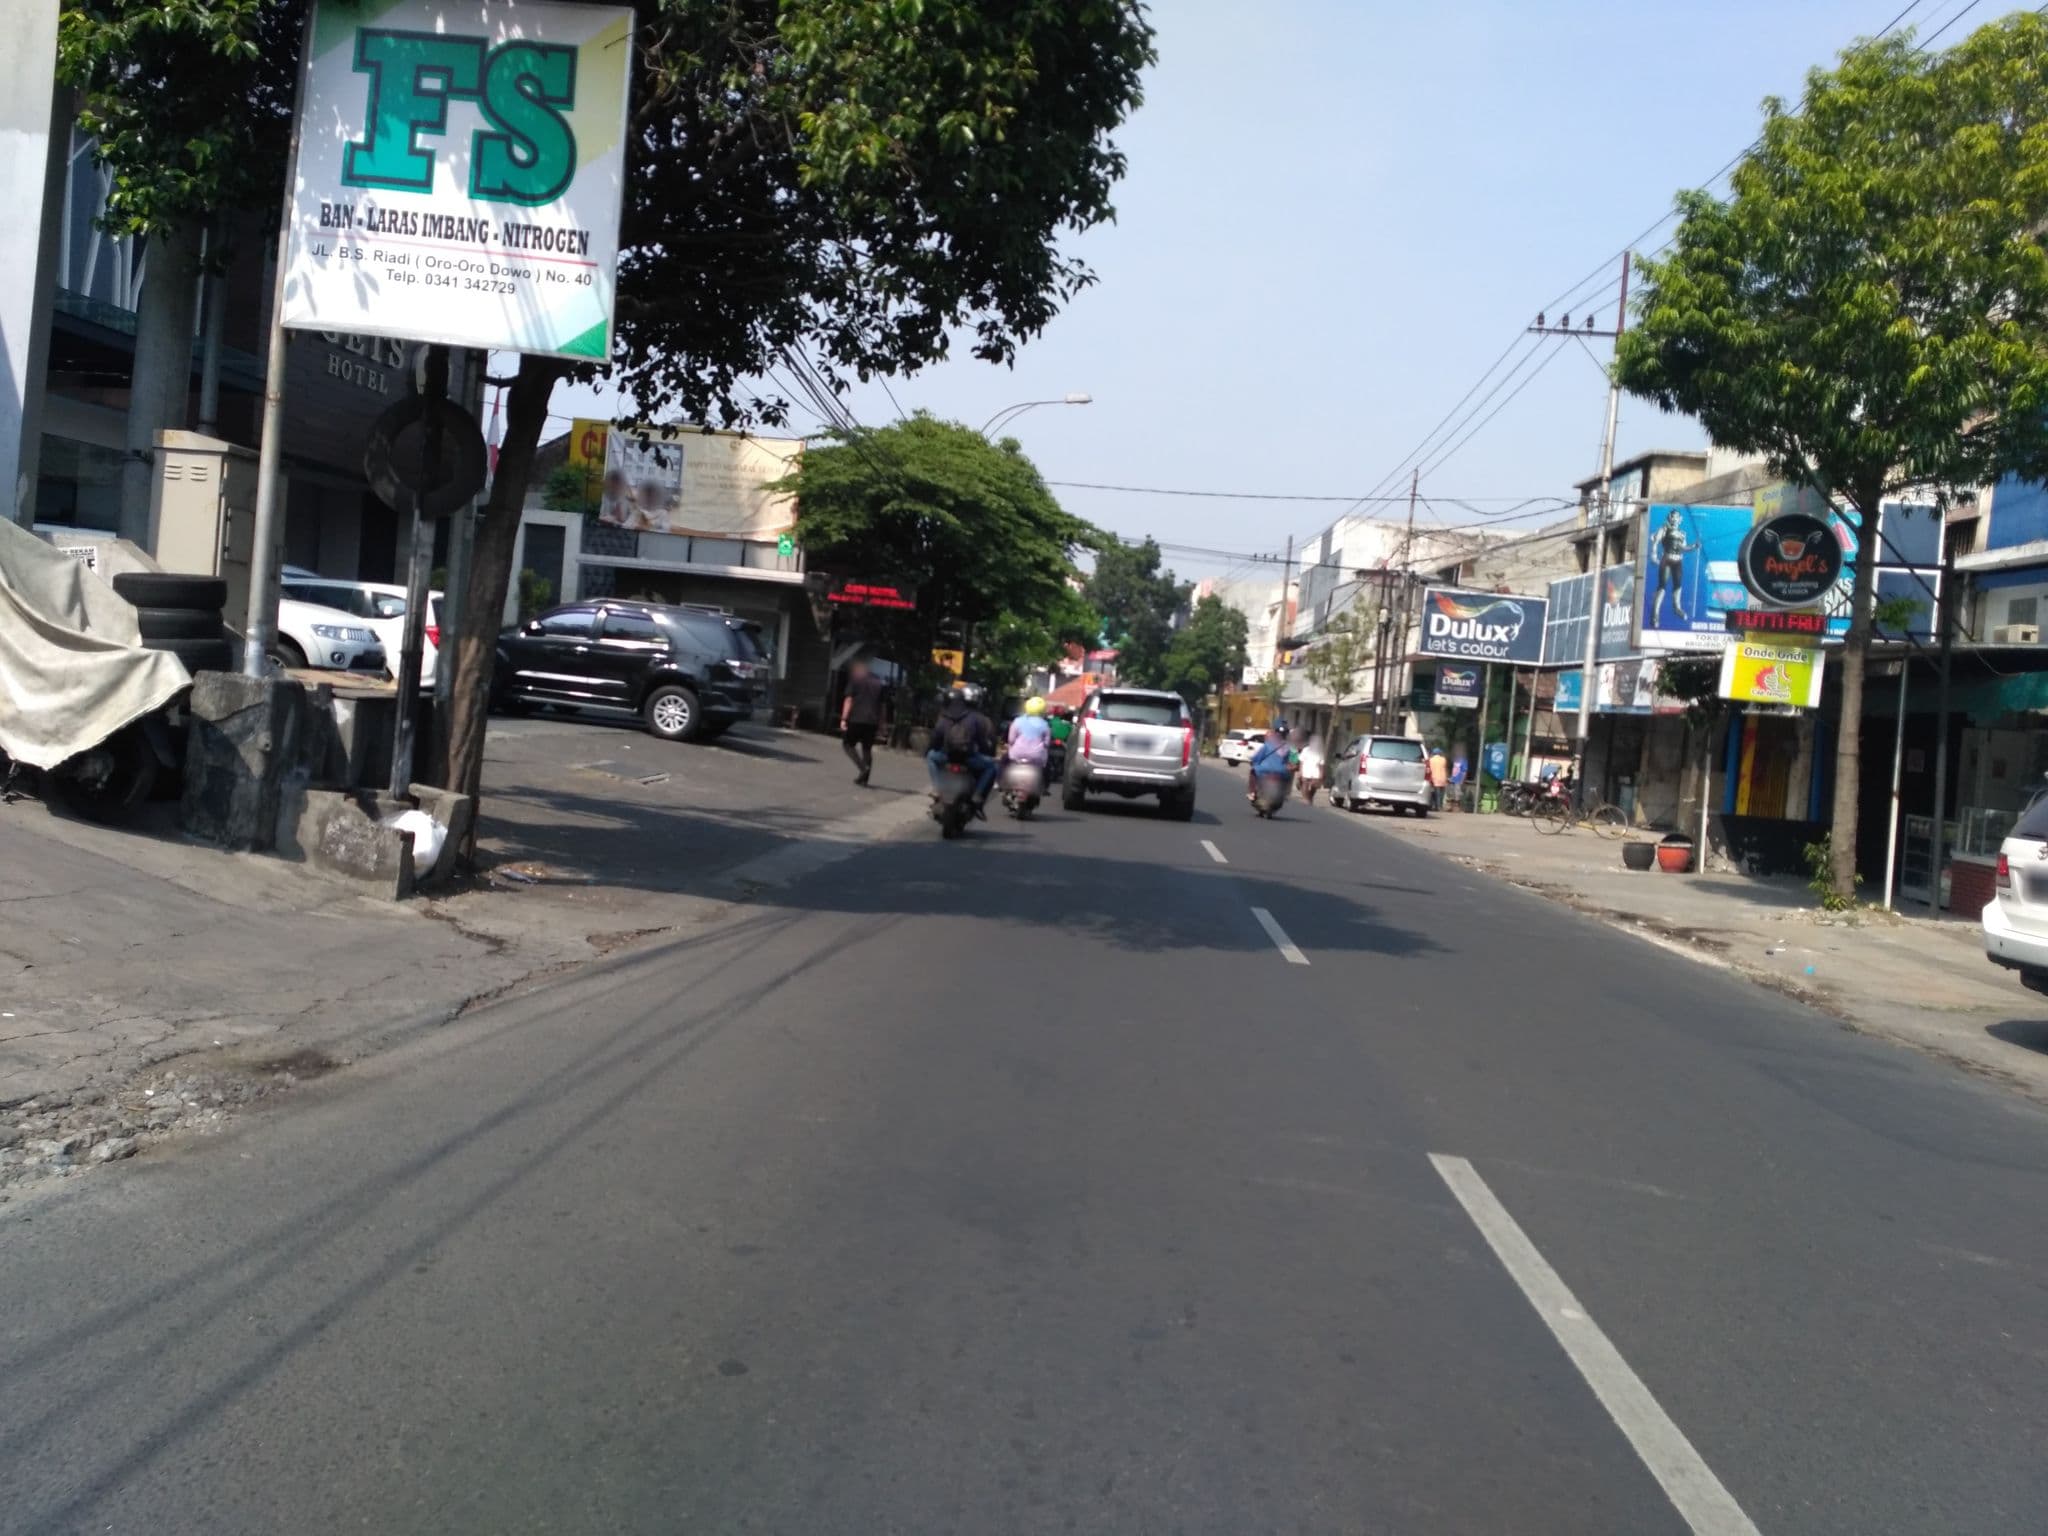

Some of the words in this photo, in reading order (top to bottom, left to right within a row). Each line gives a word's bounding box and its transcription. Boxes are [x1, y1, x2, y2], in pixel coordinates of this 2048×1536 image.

[341, 26, 579, 208] FS
[319, 202, 355, 230] BAN
[366, 207, 418, 236] LARAS
[421, 212, 489, 244] IMBANG
[502, 221, 590, 257] NITROGEN
[311, 242, 334, 258] JL.
[339, 246, 368, 261] B.S.
[373, 250, 411, 266] Riadi
[425, 255, 485, 275] Oro-Oro
[489, 261, 532, 280] Dowo
[545, 269, 571, 285] No.
[574, 273, 592, 287] 40
[386, 268, 420, 286] Telp.
[424, 273, 459, 289] 0341
[463, 277, 516, 296] 342729
[327, 352, 389, 394] HOTEL
[1764, 553, 1829, 581] Angel's
[1430, 612, 1510, 643] Dulux
[1603, 602, 1632, 627] Dulux
[1735, 610, 1784, 629] TUTTI
[1427, 637, 1457, 652] let's
[1460, 642, 1510, 657] colour
[1744, 647, 1775, 658] Onde
[1442, 675, 1471, 687] Dulux
